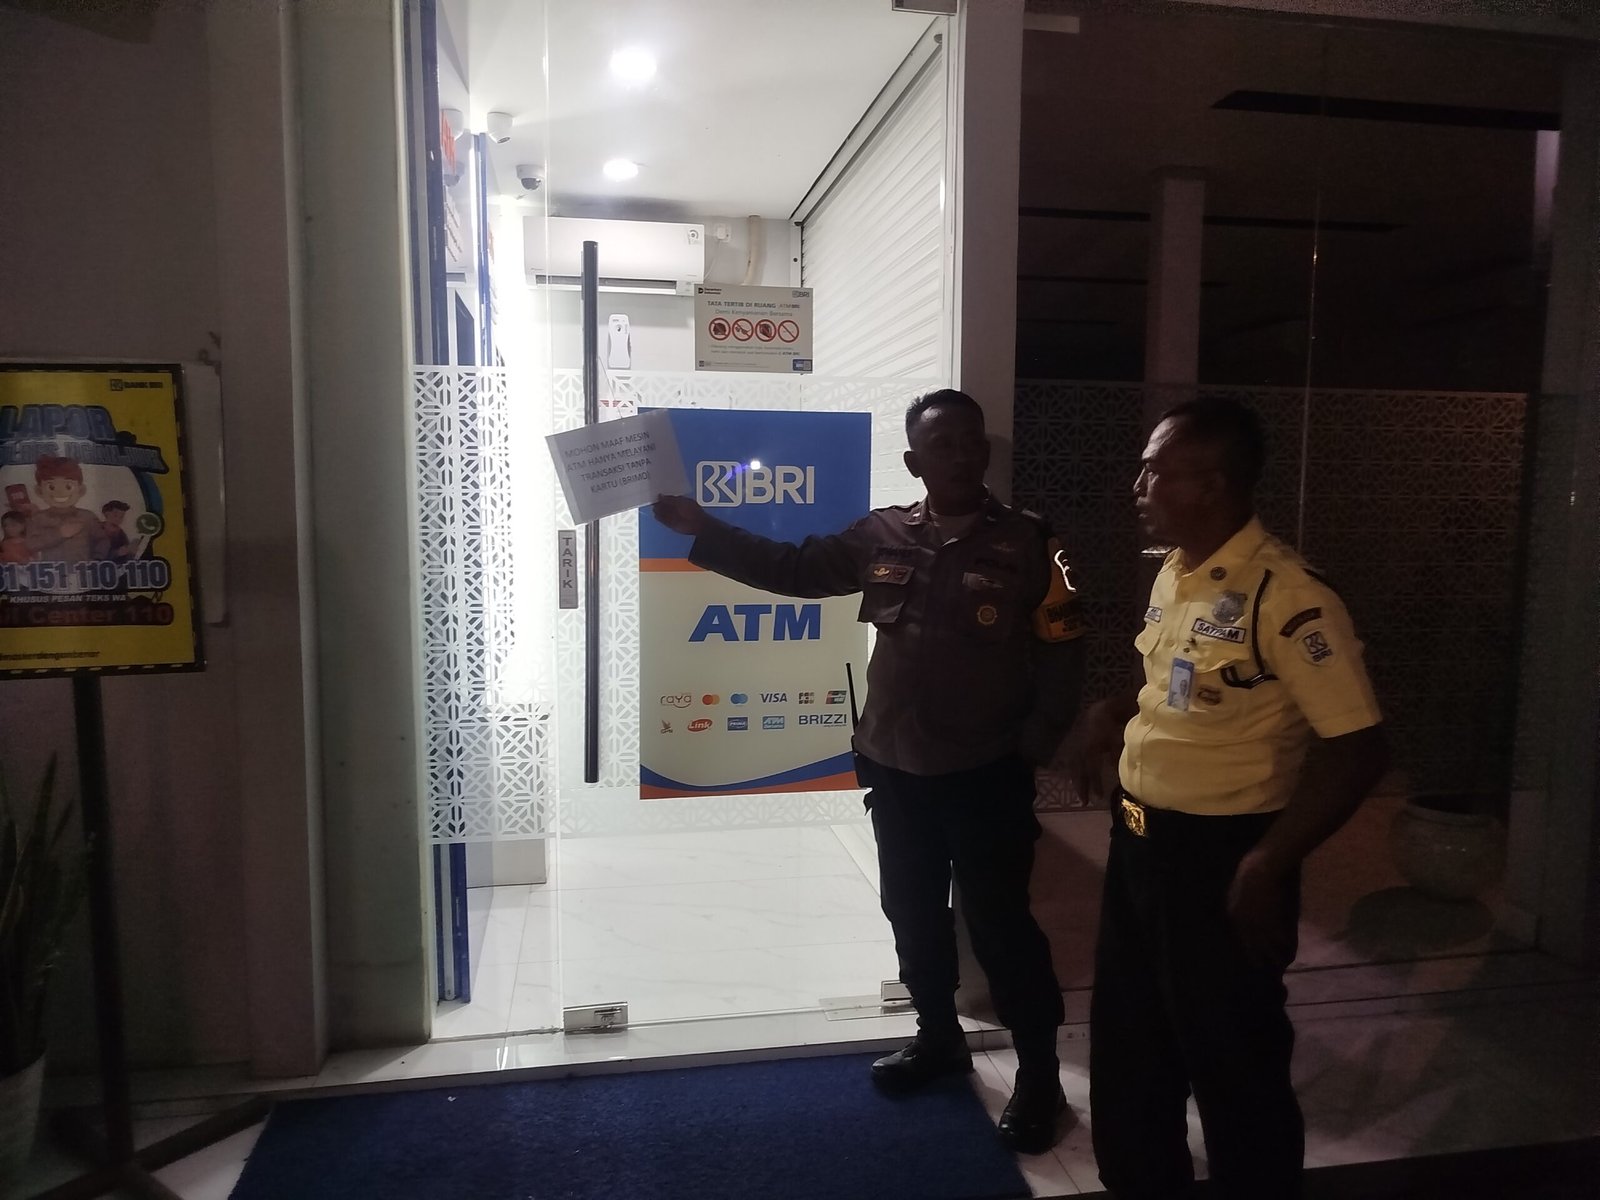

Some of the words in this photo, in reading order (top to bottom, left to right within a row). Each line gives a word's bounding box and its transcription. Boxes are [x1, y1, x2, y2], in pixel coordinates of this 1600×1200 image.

[0, 404, 118, 441] LAPOR
[564, 443, 600, 458] MOHON
[601, 437, 623, 450] MAAF
[625, 431, 650, 444] MESIN
[567, 461, 587, 472] ATM
[588, 453, 617, 466] HANYA
[617, 443, 656, 460] MELAYANI
[581, 464, 625, 481] TRANSAKSI
[626, 457, 651, 470] TANPA
[590, 480, 619, 493] KARTU
[745, 465, 815, 504] BRI
[562, 537, 573, 589] TARIK
[26, 560, 69, 592] 151
[74, 560, 119, 590] 110
[125, 560, 169, 590] 110
[10, 595, 49, 604] KHUSUS
[51, 594, 82, 603] PESAN
[85, 594, 109, 602] TEKS
[112, 593, 127, 602] WA
[31, 605, 117, 624] Center
[127, 604, 174, 623] 110
[688, 604, 821, 642] ATM
[1197, 621, 1240, 640] SATPAM
[760, 692, 788, 703] VISA
[689, 721, 711, 729] Link
[799, 714, 847, 725] BRIZZI
